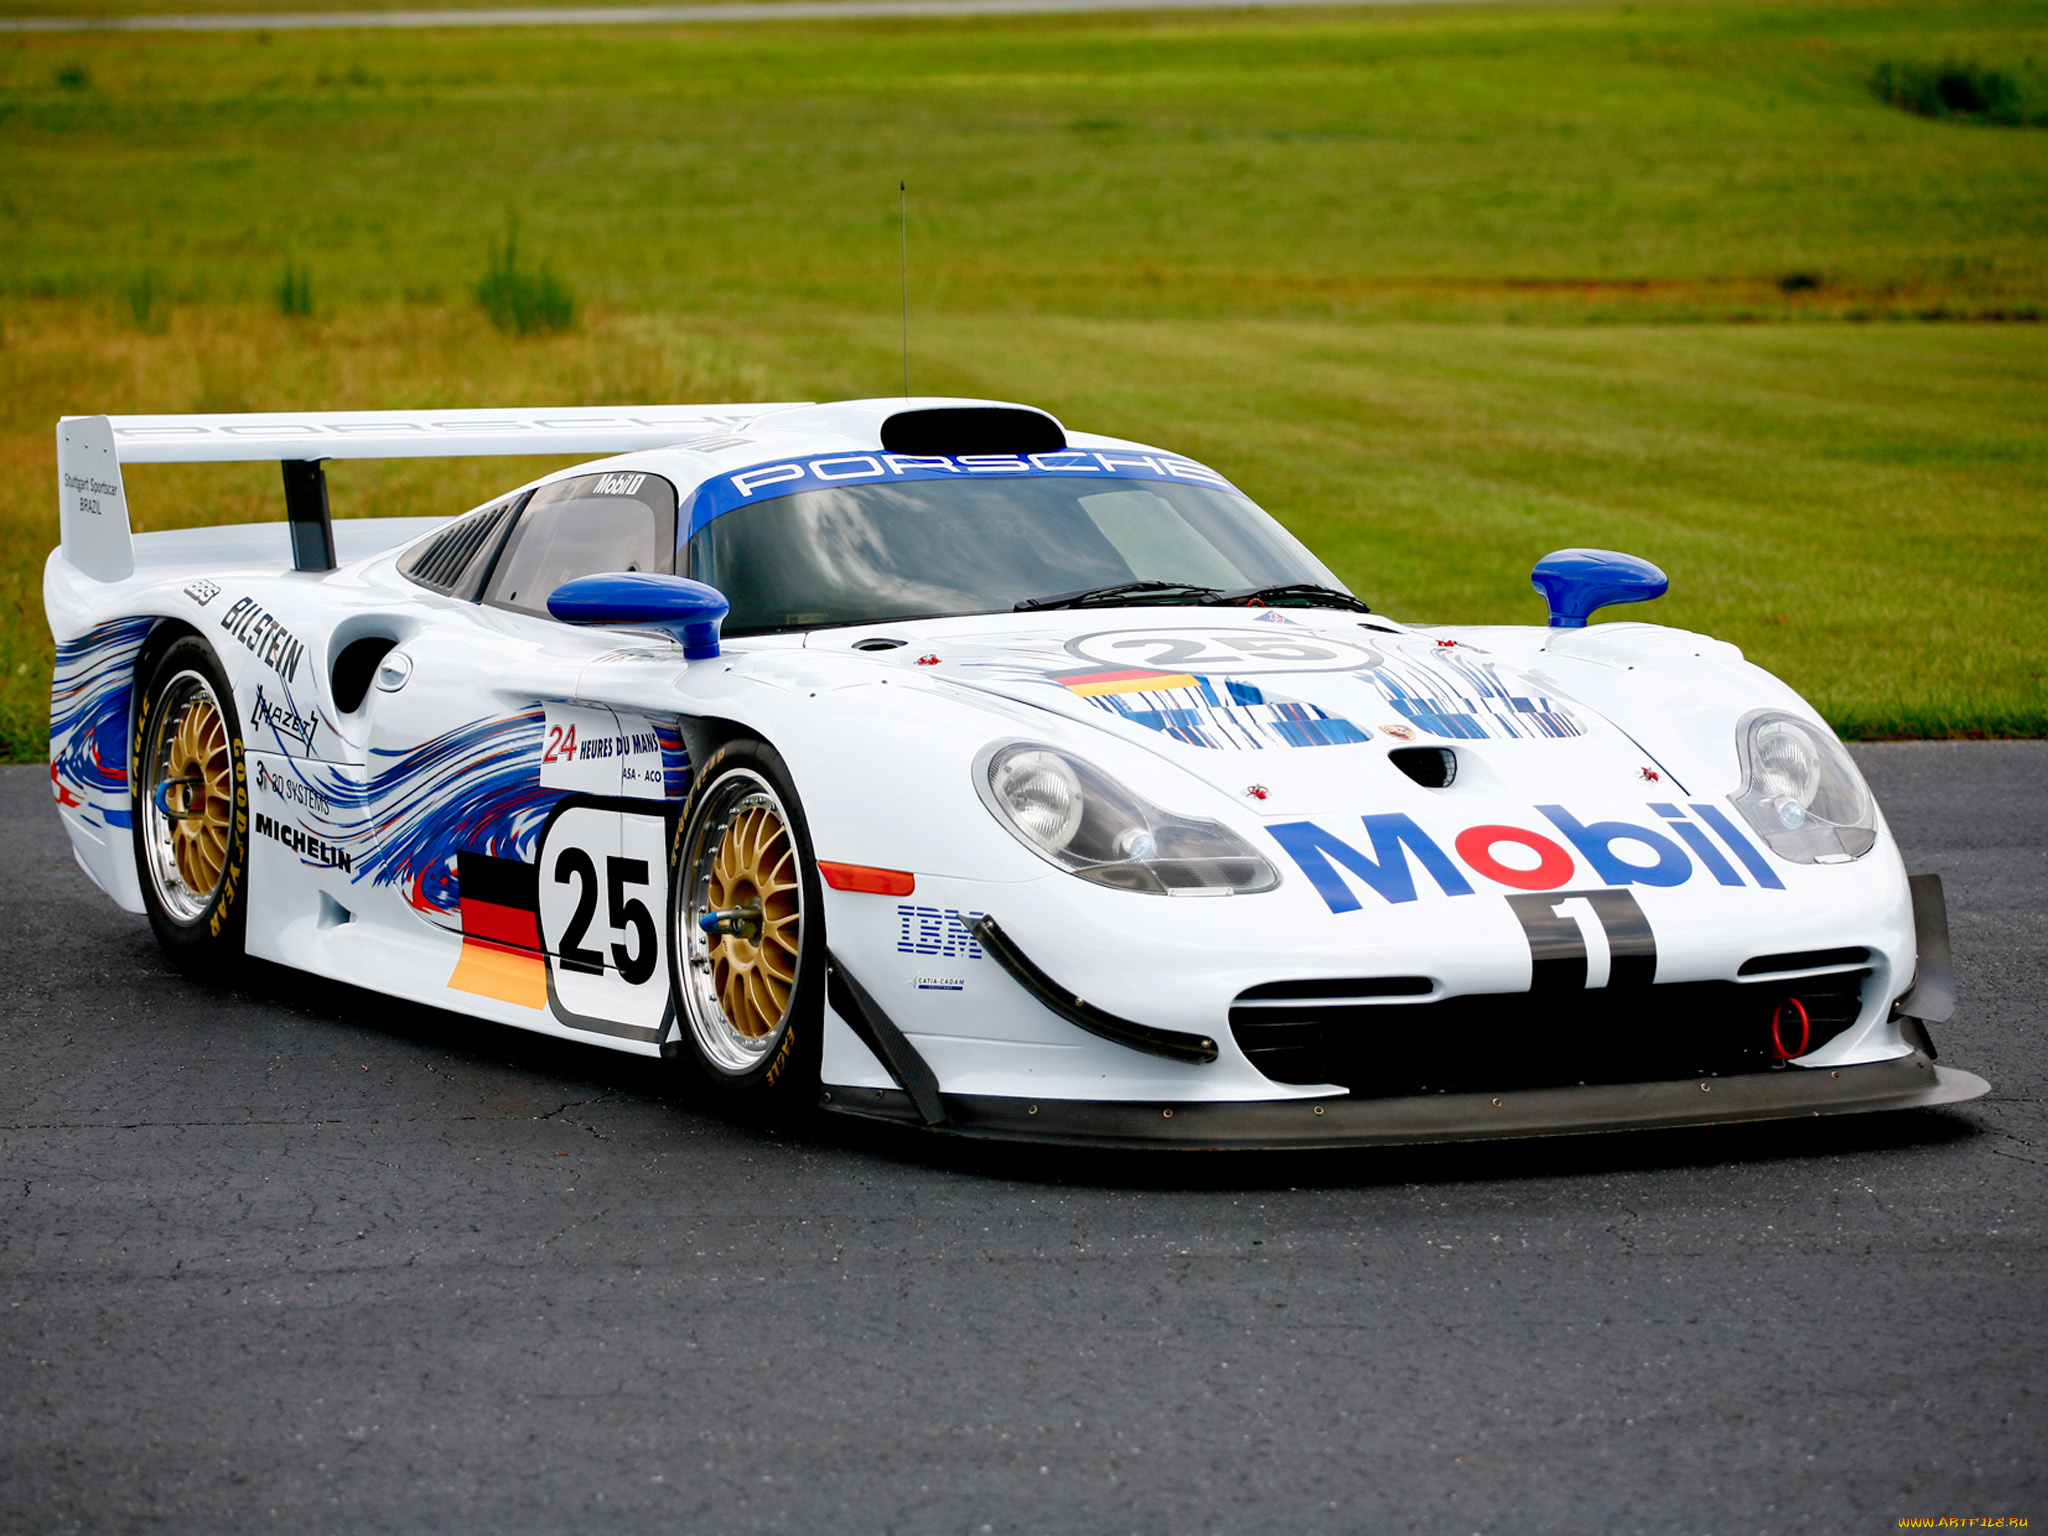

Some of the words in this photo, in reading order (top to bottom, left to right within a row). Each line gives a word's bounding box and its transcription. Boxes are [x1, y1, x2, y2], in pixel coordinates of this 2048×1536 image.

[64, 473, 89, 492] Stuttgart
[90, 478, 117, 496] Sportscar
[593, 473, 635, 495] Mobil
[730, 451, 1230, 497] PORSCHE
[79, 497, 102, 515] BRAZIL
[183, 579, 221, 606] BBS
[221, 596, 304, 684] BILSTEIN
[1111, 636, 1339, 665] 25
[258, 698, 311, 736] HAZET
[541, 722, 578, 765] 24
[579, 737, 613, 760] HEURES
[616, 734, 630, 756] DU
[631, 732, 659, 754] MANS
[272, 773, 285, 796] 3D
[286, 779, 330, 815] SYSTEMS
[622, 767, 636, 780] ASA
[644, 769, 662, 783] ACO
[255, 812, 351, 874] MICHELIN
[1264, 803, 1787, 914] Mobil
[554, 847, 658, 985] 25
[897, 905, 984, 959] IBM
[1551, 896, 1612, 990] 1
[766, 1025, 796, 1087] EAGLE
